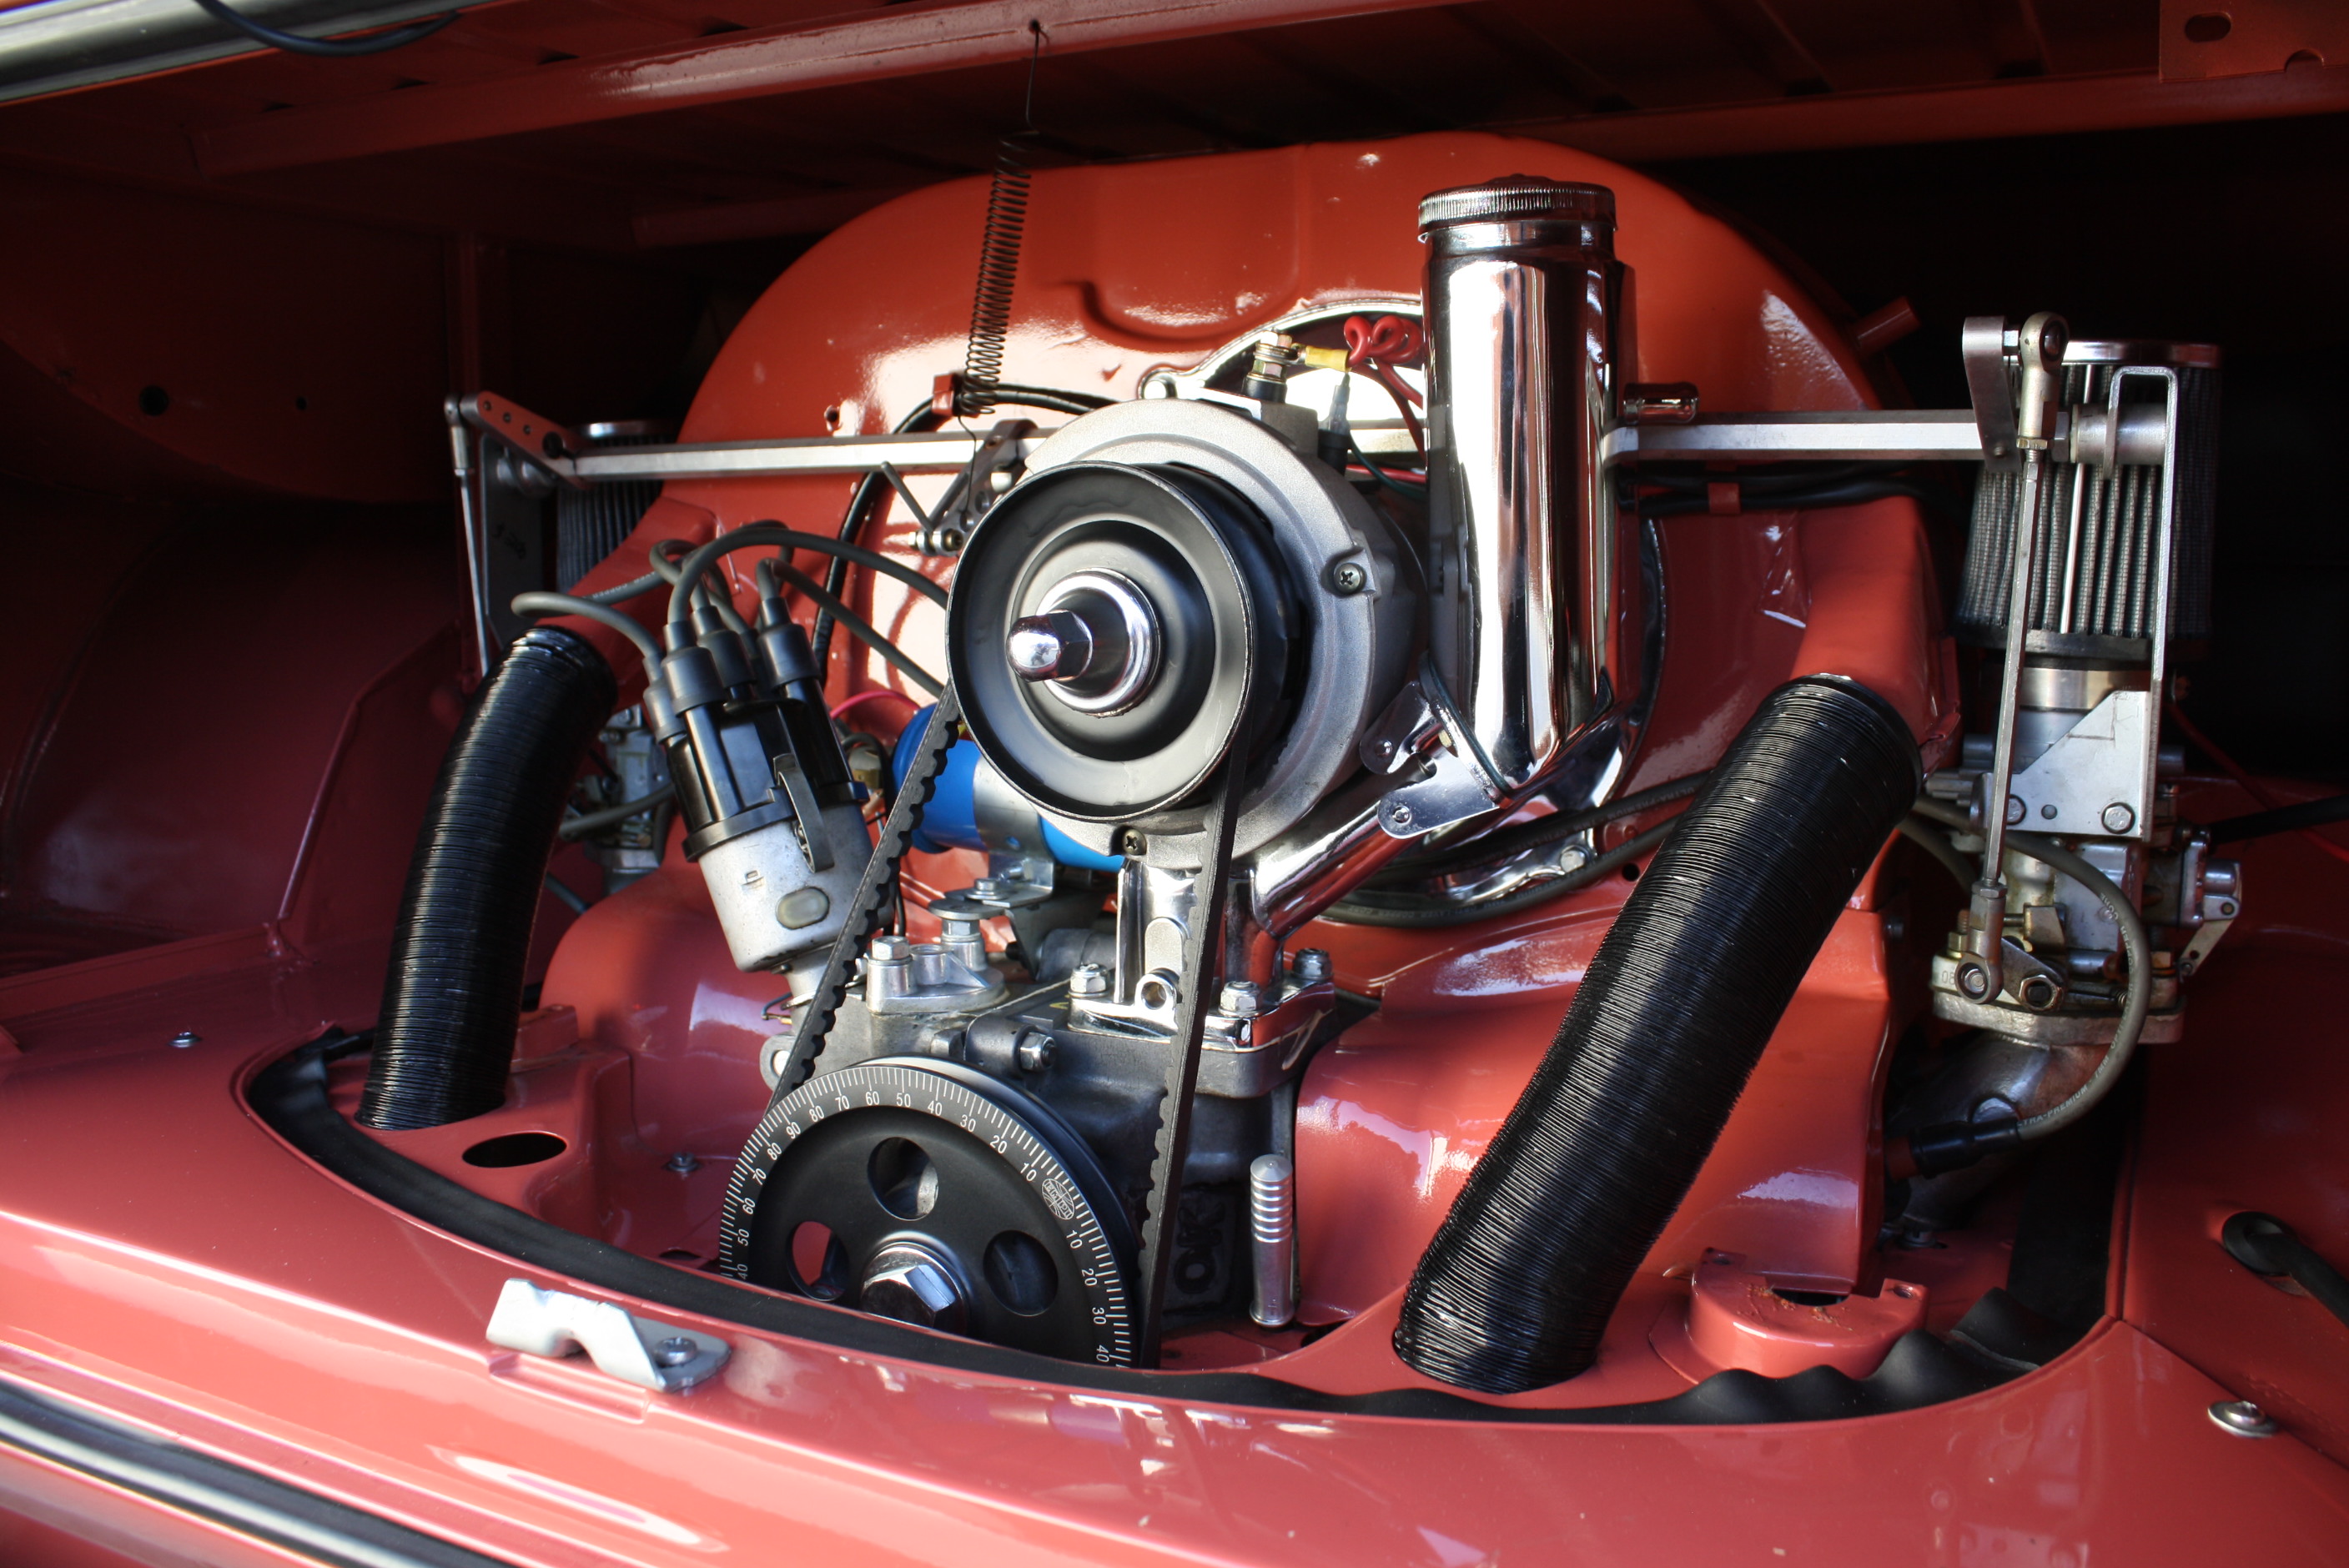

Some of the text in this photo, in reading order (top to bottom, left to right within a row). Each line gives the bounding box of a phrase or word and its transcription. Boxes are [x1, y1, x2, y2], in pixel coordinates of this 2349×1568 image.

[835, 1095, 850, 1112] 70
[865, 1091, 880, 1106] 60
[896, 1093, 911, 1108] 50
[2016, 1084, 2088, 1127] LTRA-PREMIUM
[808, 1105, 825, 1123] 80
[927, 1100, 943, 1116] 40
[786, 1122, 801, 1139] 90
[959, 1114, 976, 1132] 30
[767, 1143, 782, 1161] 80
[989, 1135, 1008, 1154] 20
[752, 1168, 767, 1185] 70
[1020, 1162, 1037, 1182] 10
[742, 1197, 756, 1214] 60
[737, 1229, 750, 1246] 50
[1066, 1229, 1083, 1249] 10
[737, 1264, 748, 1280] 40
[1081, 1268, 1098, 1286] 20
[1092, 1307, 1107, 1325] 30
[1095, 1344, 1109, 1363] 40
